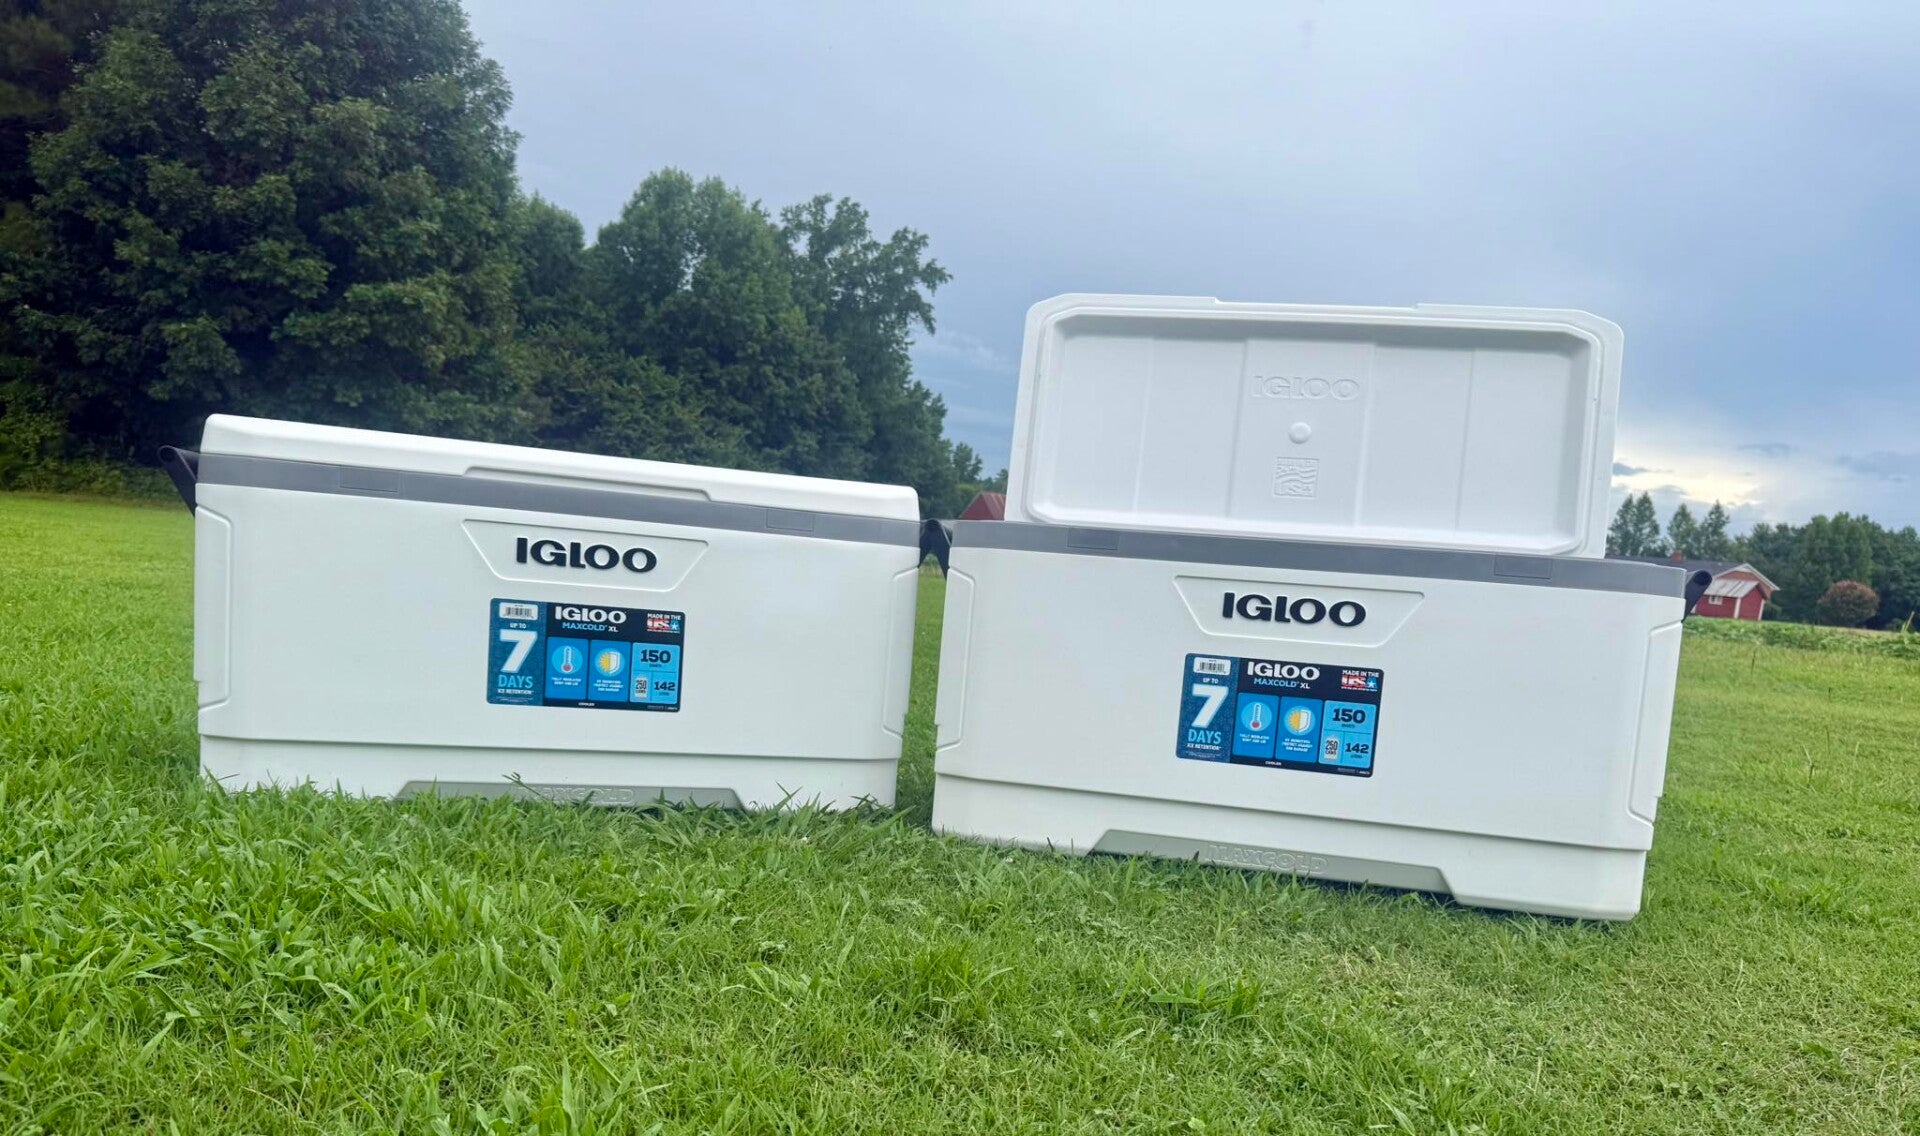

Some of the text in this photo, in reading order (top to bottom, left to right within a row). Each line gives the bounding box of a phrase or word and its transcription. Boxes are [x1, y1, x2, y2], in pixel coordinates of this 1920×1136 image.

[1252, 375, 1360, 400] IGLOO
[516, 537, 657, 573] IGLOO
[555, 606, 627, 624] IGLOO
[1222, 592, 1366, 627] IGLOO
[562, 622, 606, 631] MAXCOLD
[500, 628, 538, 673] 7
[641, 649, 671, 663] 150
[1247, 661, 1320, 680] IGLOO
[498, 674, 533, 689] DAYS
[635, 679, 647, 690] 250
[654, 681, 675, 691] 142
[1253, 678, 1297, 688] MAXCOLD
[1191, 683, 1229, 728] 7
[1332, 708, 1366, 724] 150
[1188, 729, 1222, 744] DAYS
[1325, 740, 1339, 751] 250
[1345, 743, 1370, 754] 142
